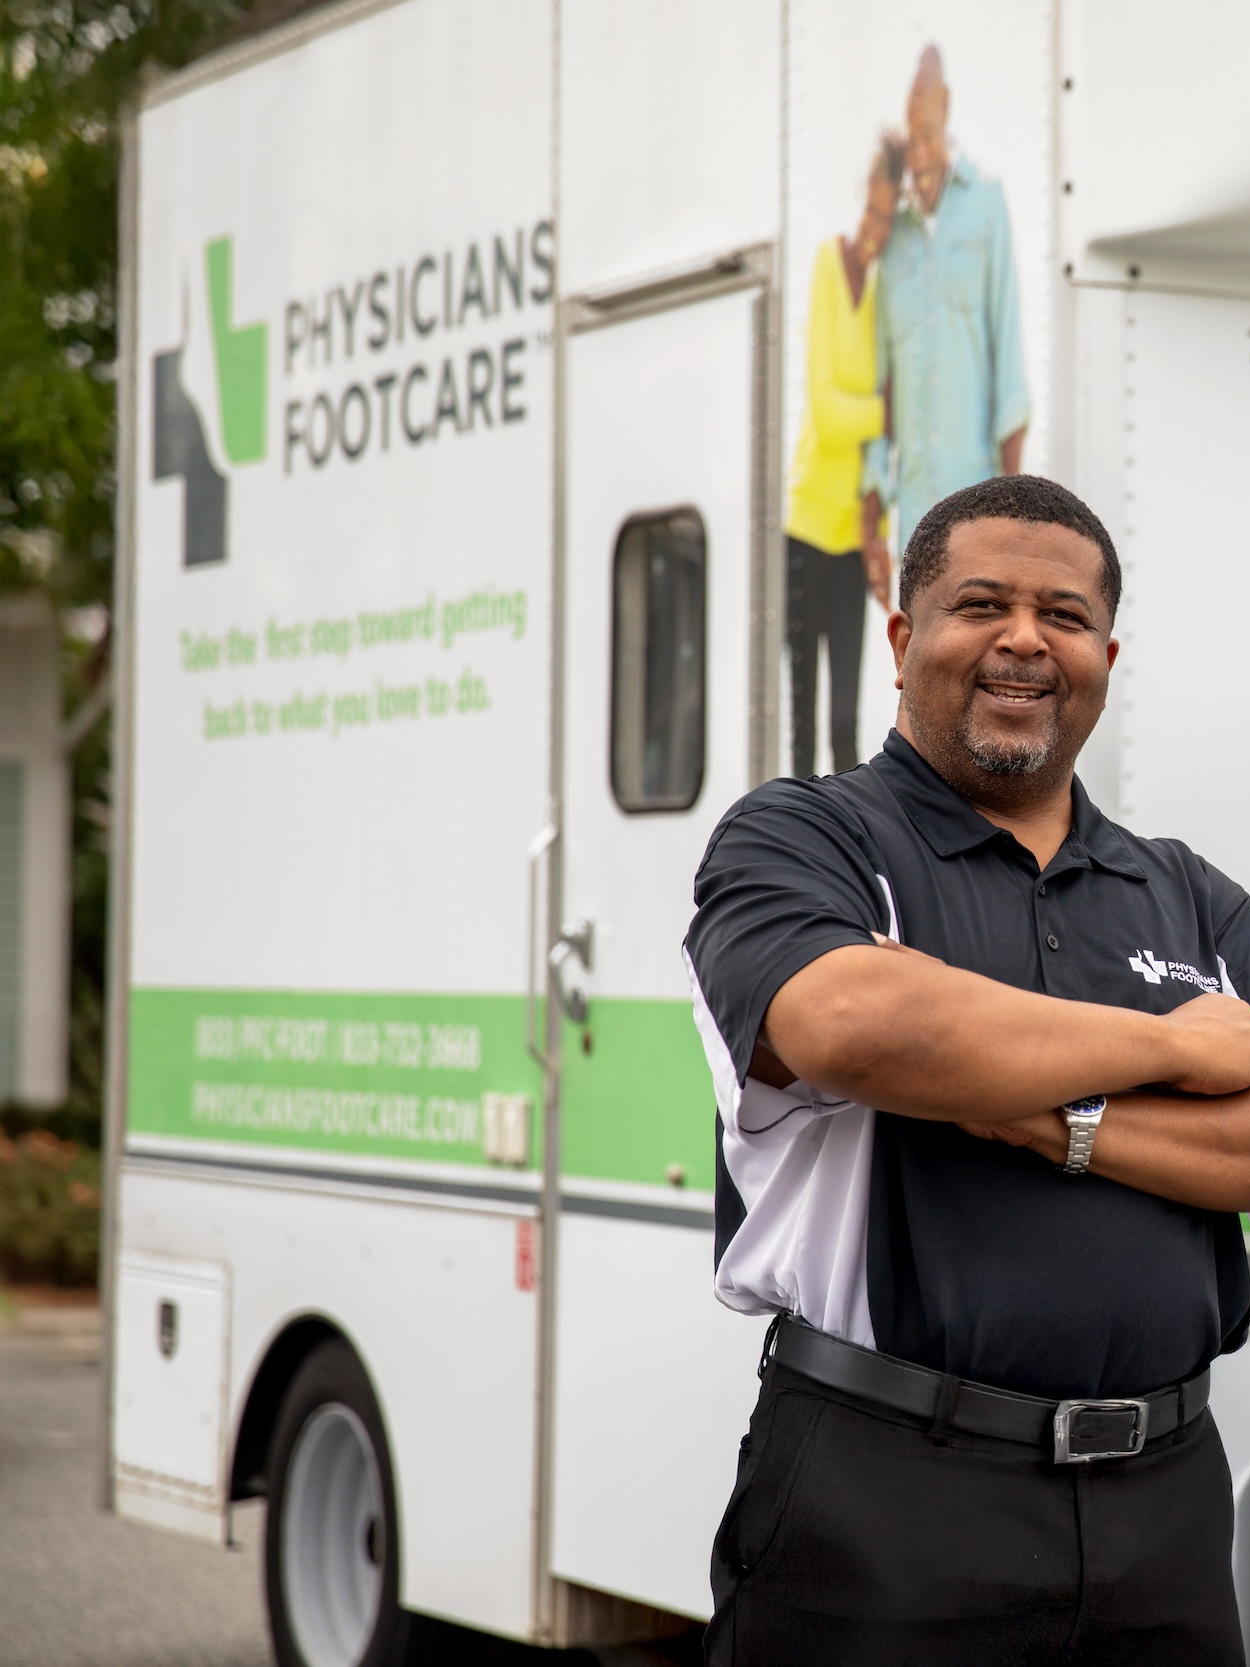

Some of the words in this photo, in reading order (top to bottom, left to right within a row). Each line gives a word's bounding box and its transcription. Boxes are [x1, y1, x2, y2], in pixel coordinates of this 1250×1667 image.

[284, 218, 555, 376] PHYSICIANS
[283, 337, 526, 478] FOOTCARE
[440, 584, 527, 650] getting
